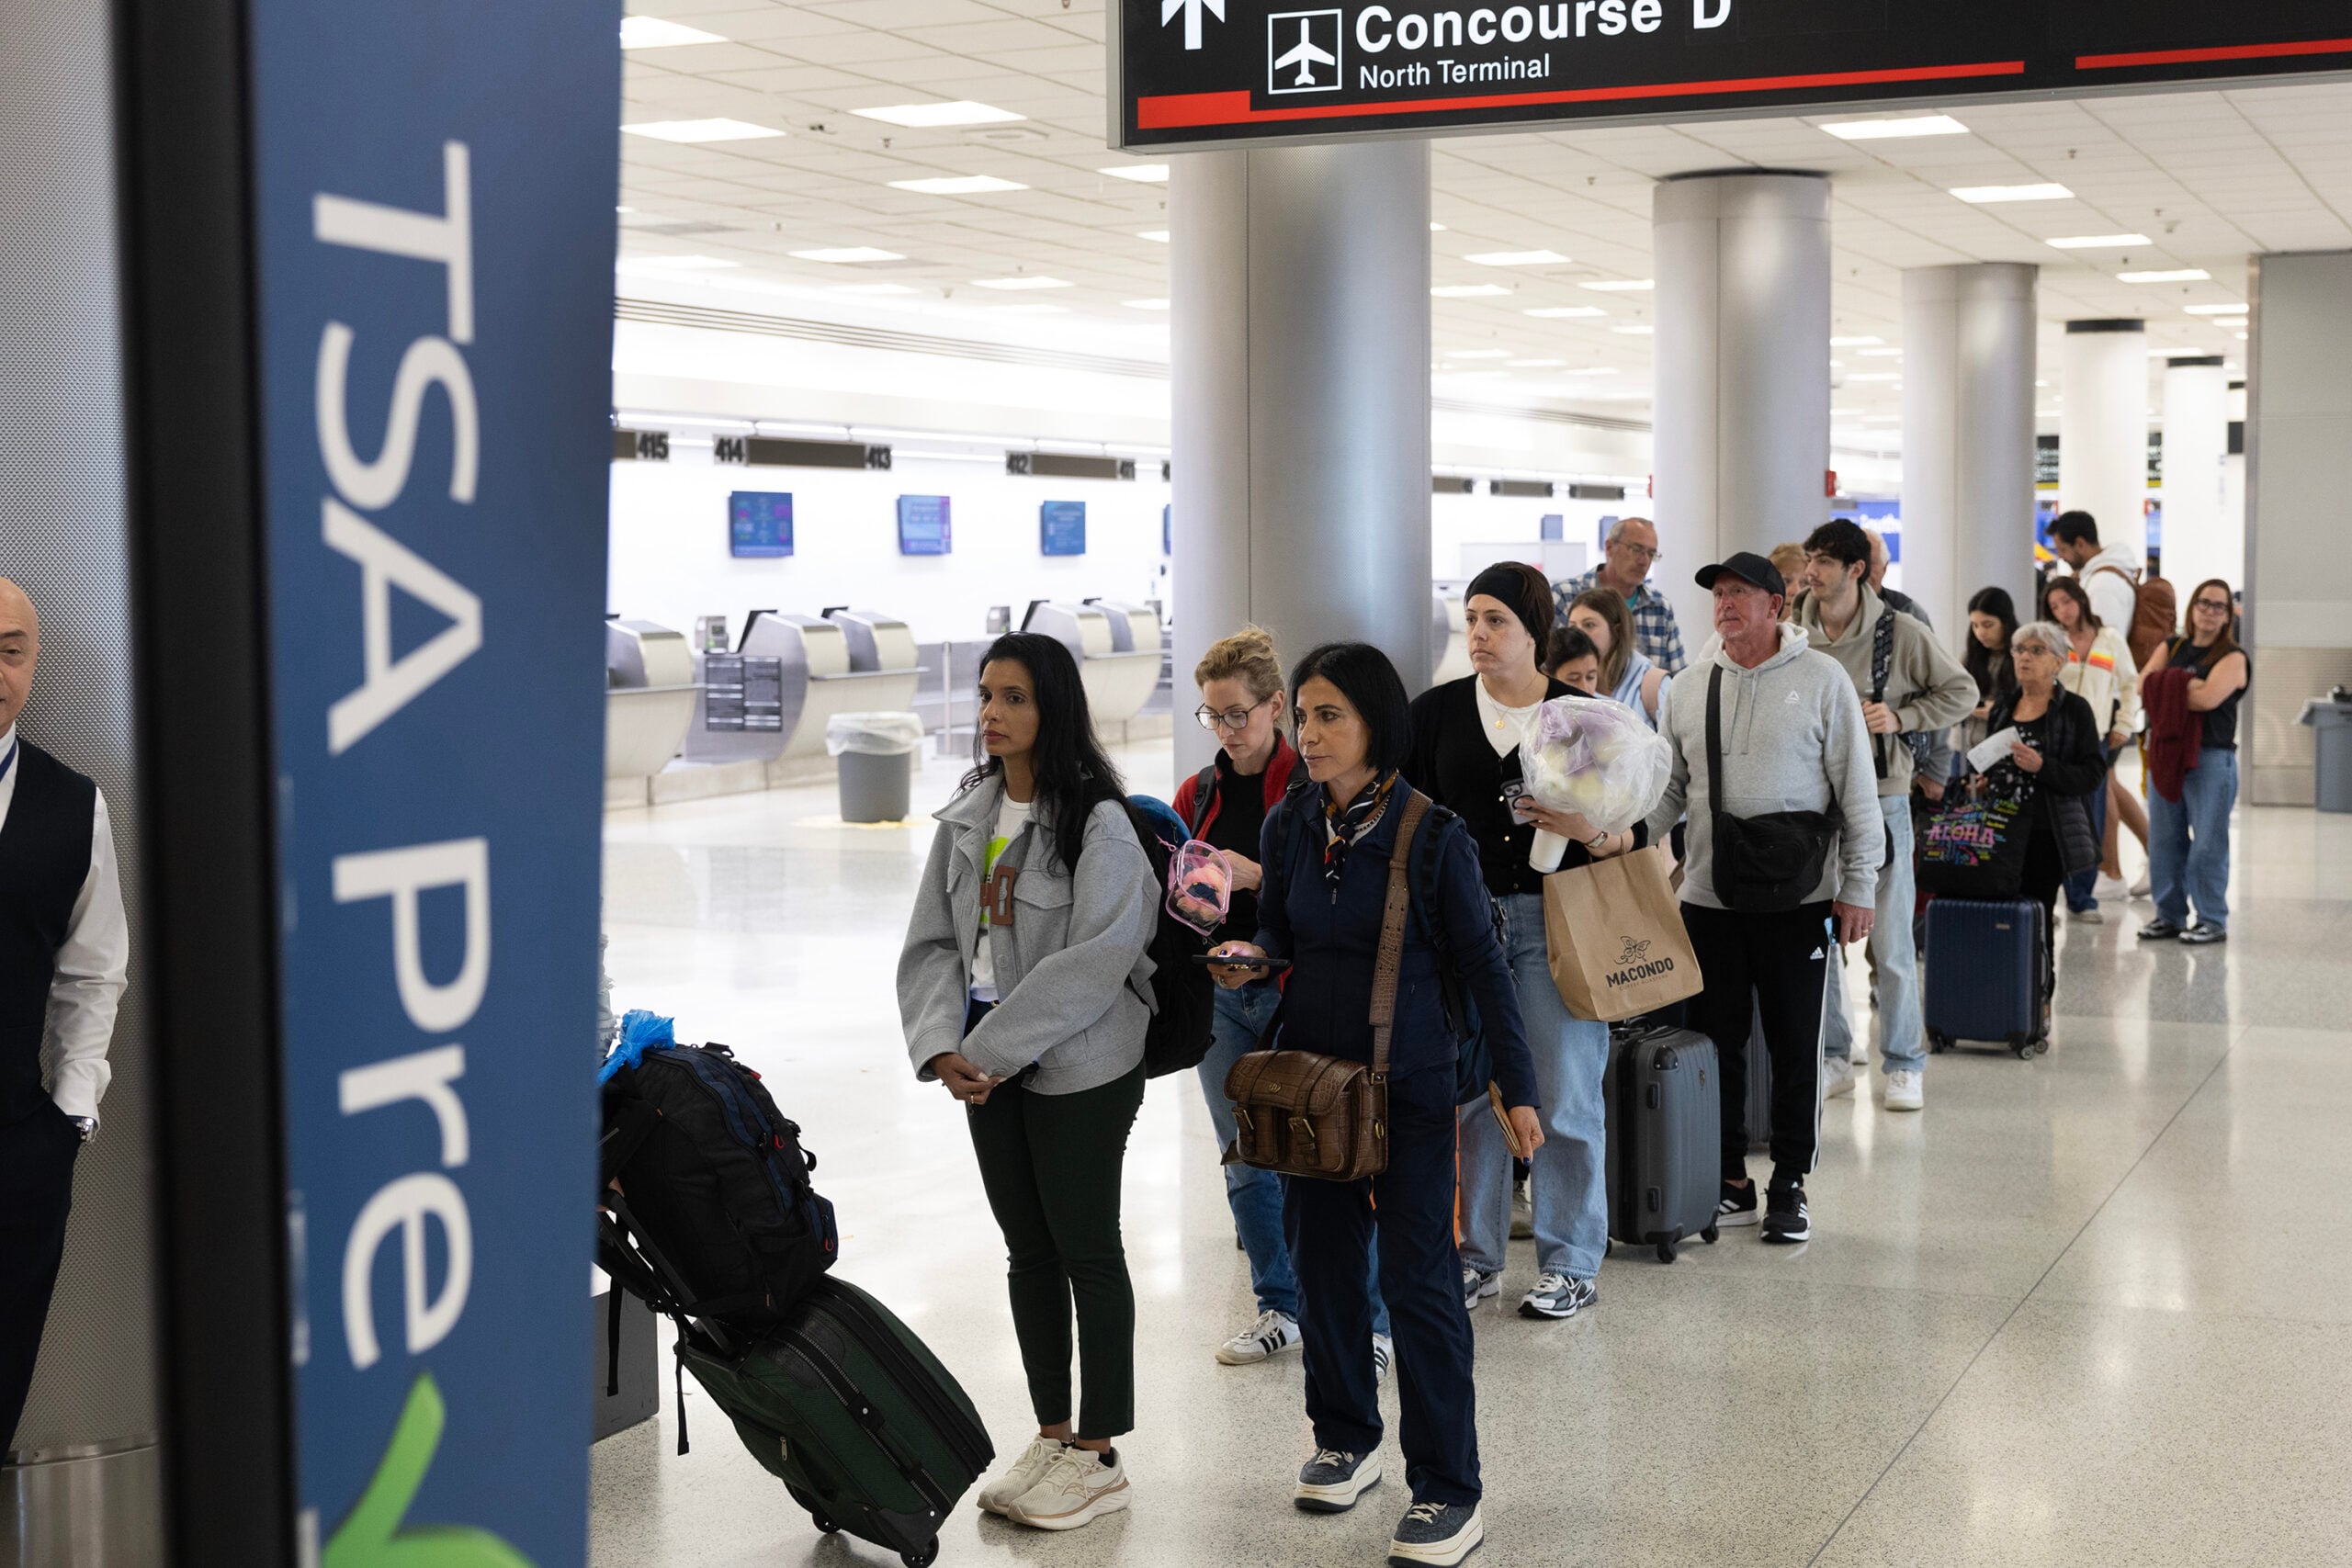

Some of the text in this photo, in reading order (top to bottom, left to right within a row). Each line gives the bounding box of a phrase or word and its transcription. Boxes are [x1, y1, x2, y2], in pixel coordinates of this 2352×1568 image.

[1356, 0, 1732, 53] Concourse D
[1360, 52, 1550, 90] North Terminal
[636, 433, 669, 459] 415
[714, 437, 745, 462] 414
[868, 446, 891, 469] 413
[1006, 453, 1029, 475] 412
[314, 141, 489, 1367] TSA Pre
[1928, 823, 1996, 845] ALOHA
[1605, 957, 1674, 988] MACONDO
